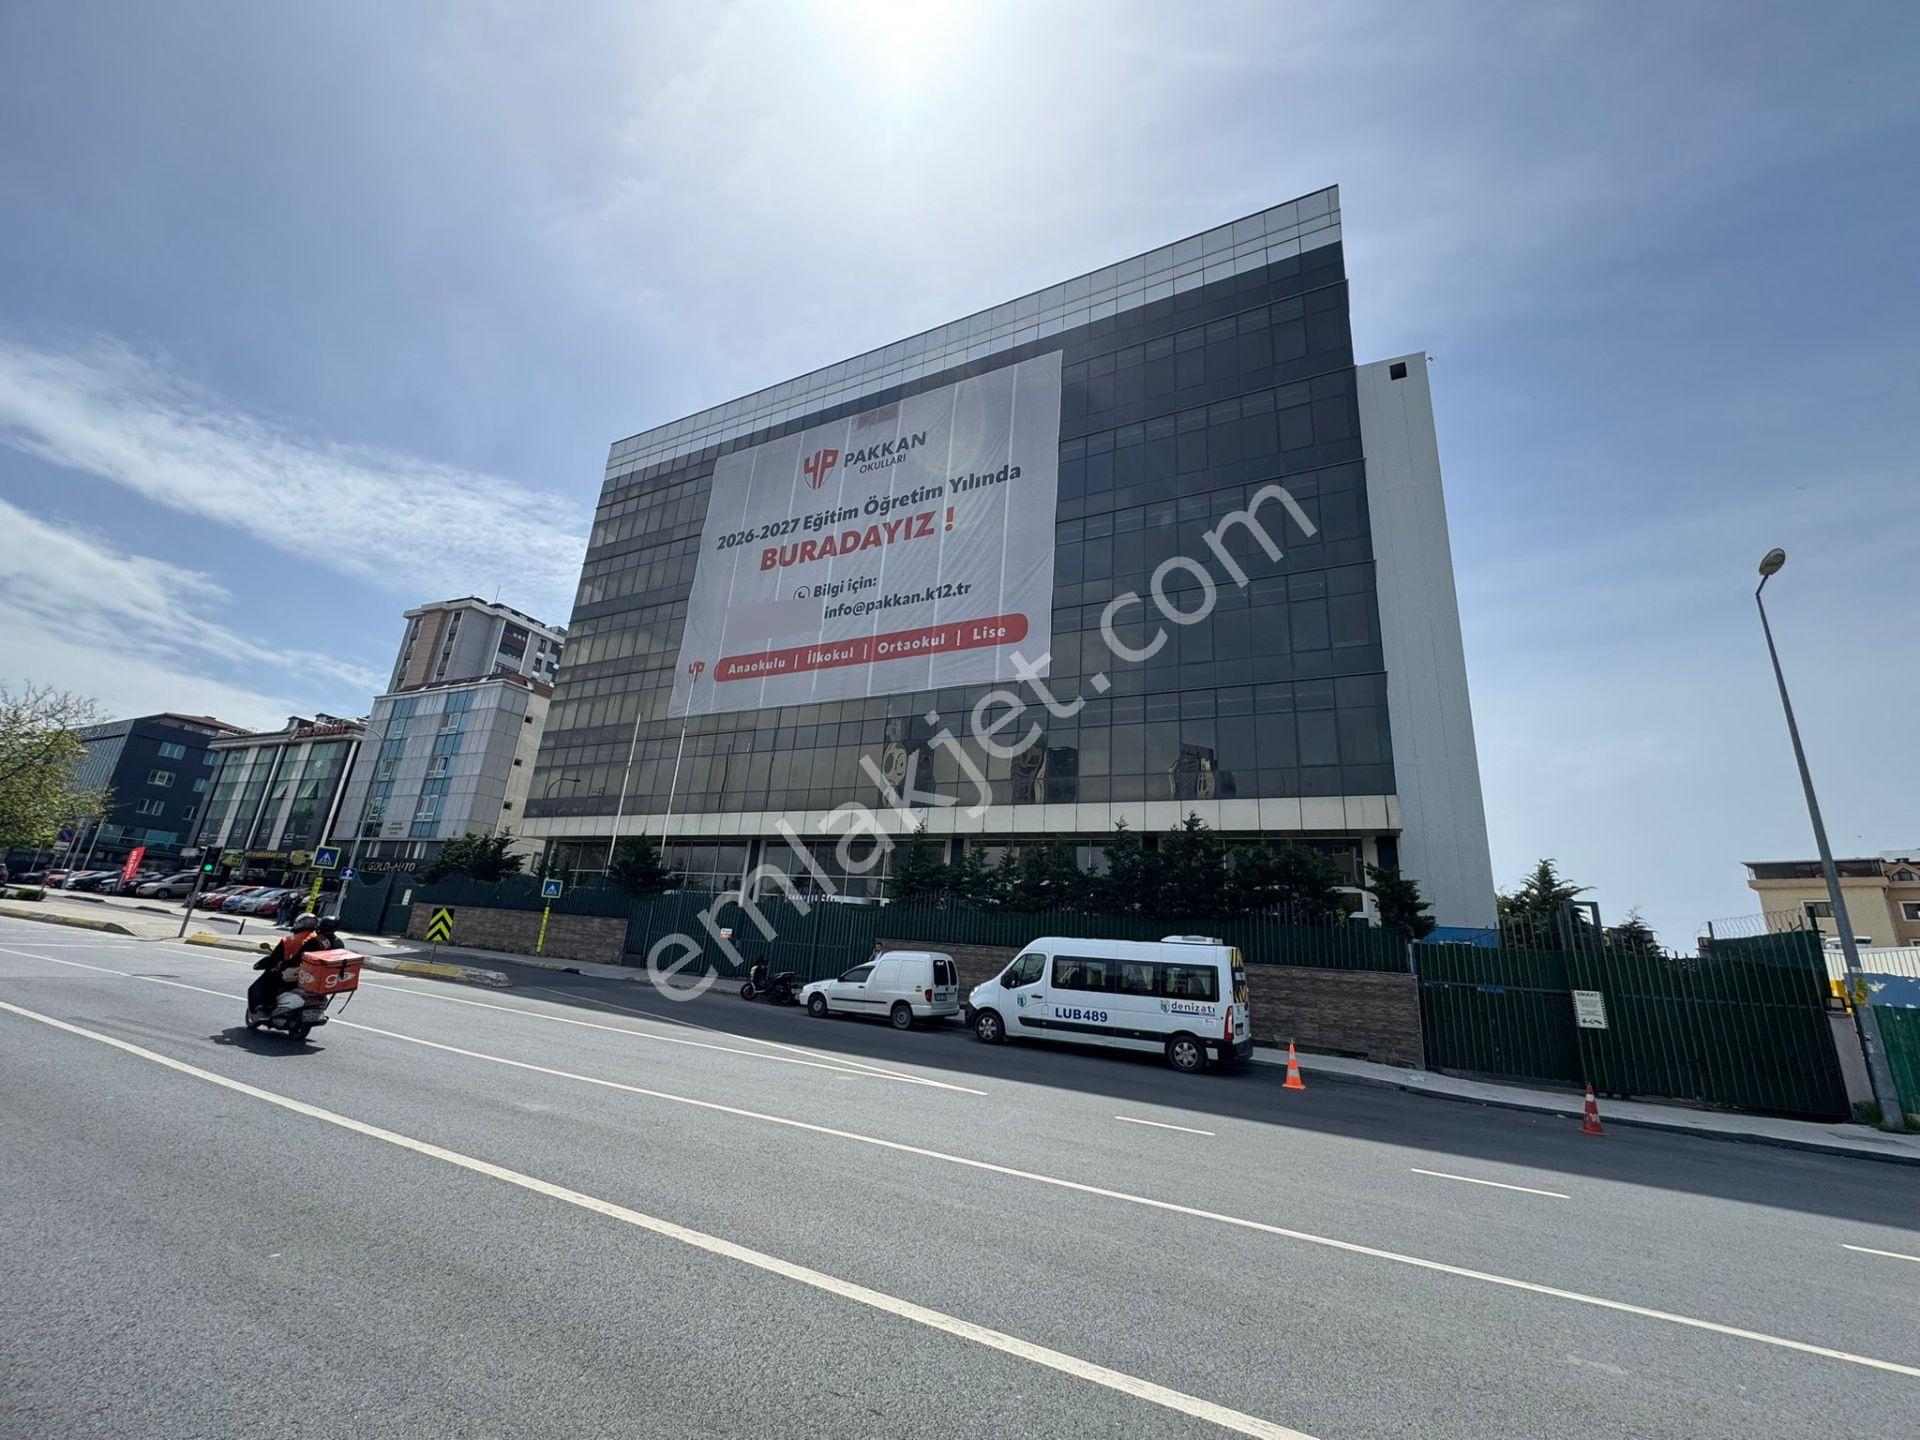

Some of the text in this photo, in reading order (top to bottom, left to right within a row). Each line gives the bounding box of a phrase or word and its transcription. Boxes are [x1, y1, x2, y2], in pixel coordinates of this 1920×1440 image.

[843, 431, 926, 468] PAKKAN
[859, 453, 906, 474] OKULLARI
[716, 464, 1021, 550] 2026-2027 Eğitim Öğretim Yılında
[760, 510, 937, 571] BURADAYIZ
[813, 576, 878, 599] Bilgi için:
[823, 582, 972, 620] info@pakkan.k12.tr
[727, 626, 1007, 675] Anaokulu İlkokul Ortaokul Lise
[1055, 1007, 1108, 1022] LUB489
